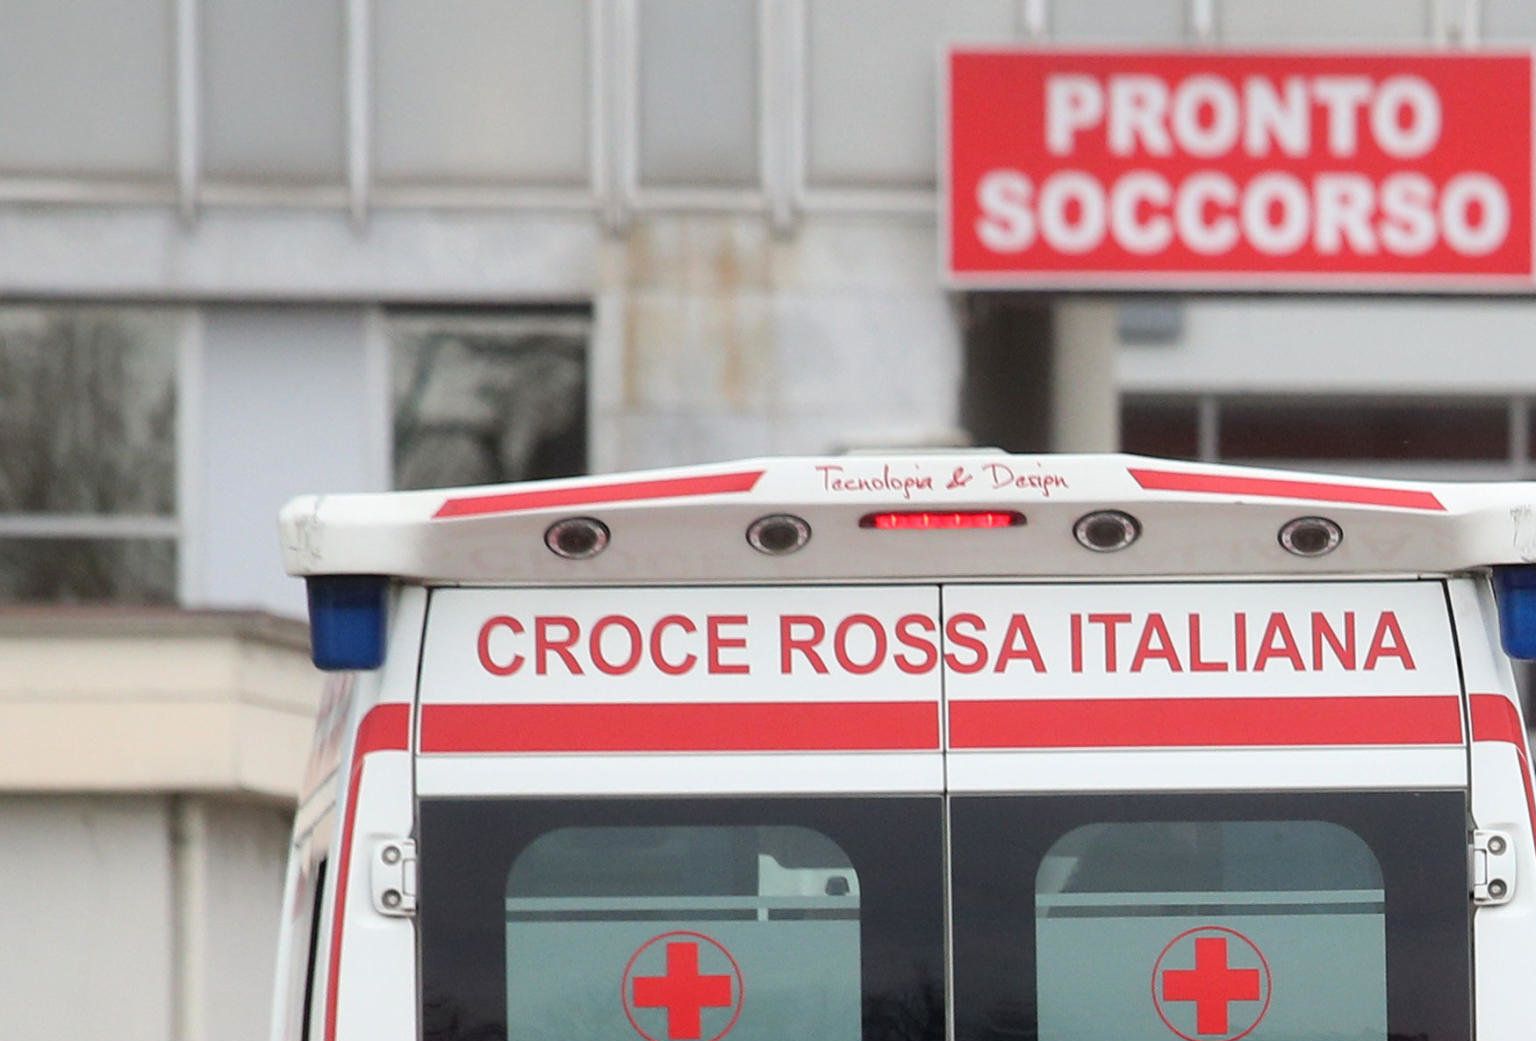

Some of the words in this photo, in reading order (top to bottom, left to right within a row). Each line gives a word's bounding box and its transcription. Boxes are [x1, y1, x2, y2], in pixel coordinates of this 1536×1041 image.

[1044, 74, 1442, 159] PRONTO
[976, 170, 1511, 256] SOCCORSO
[815, 464, 934, 499] Tecnologia
[945, 466, 974, 490] &
[982, 463, 1069, 497] Design
[477, 614, 751, 677] CROCE
[780, 612, 1047, 676] ROSSA
[1071, 610, 1416, 673] ITALIANA
